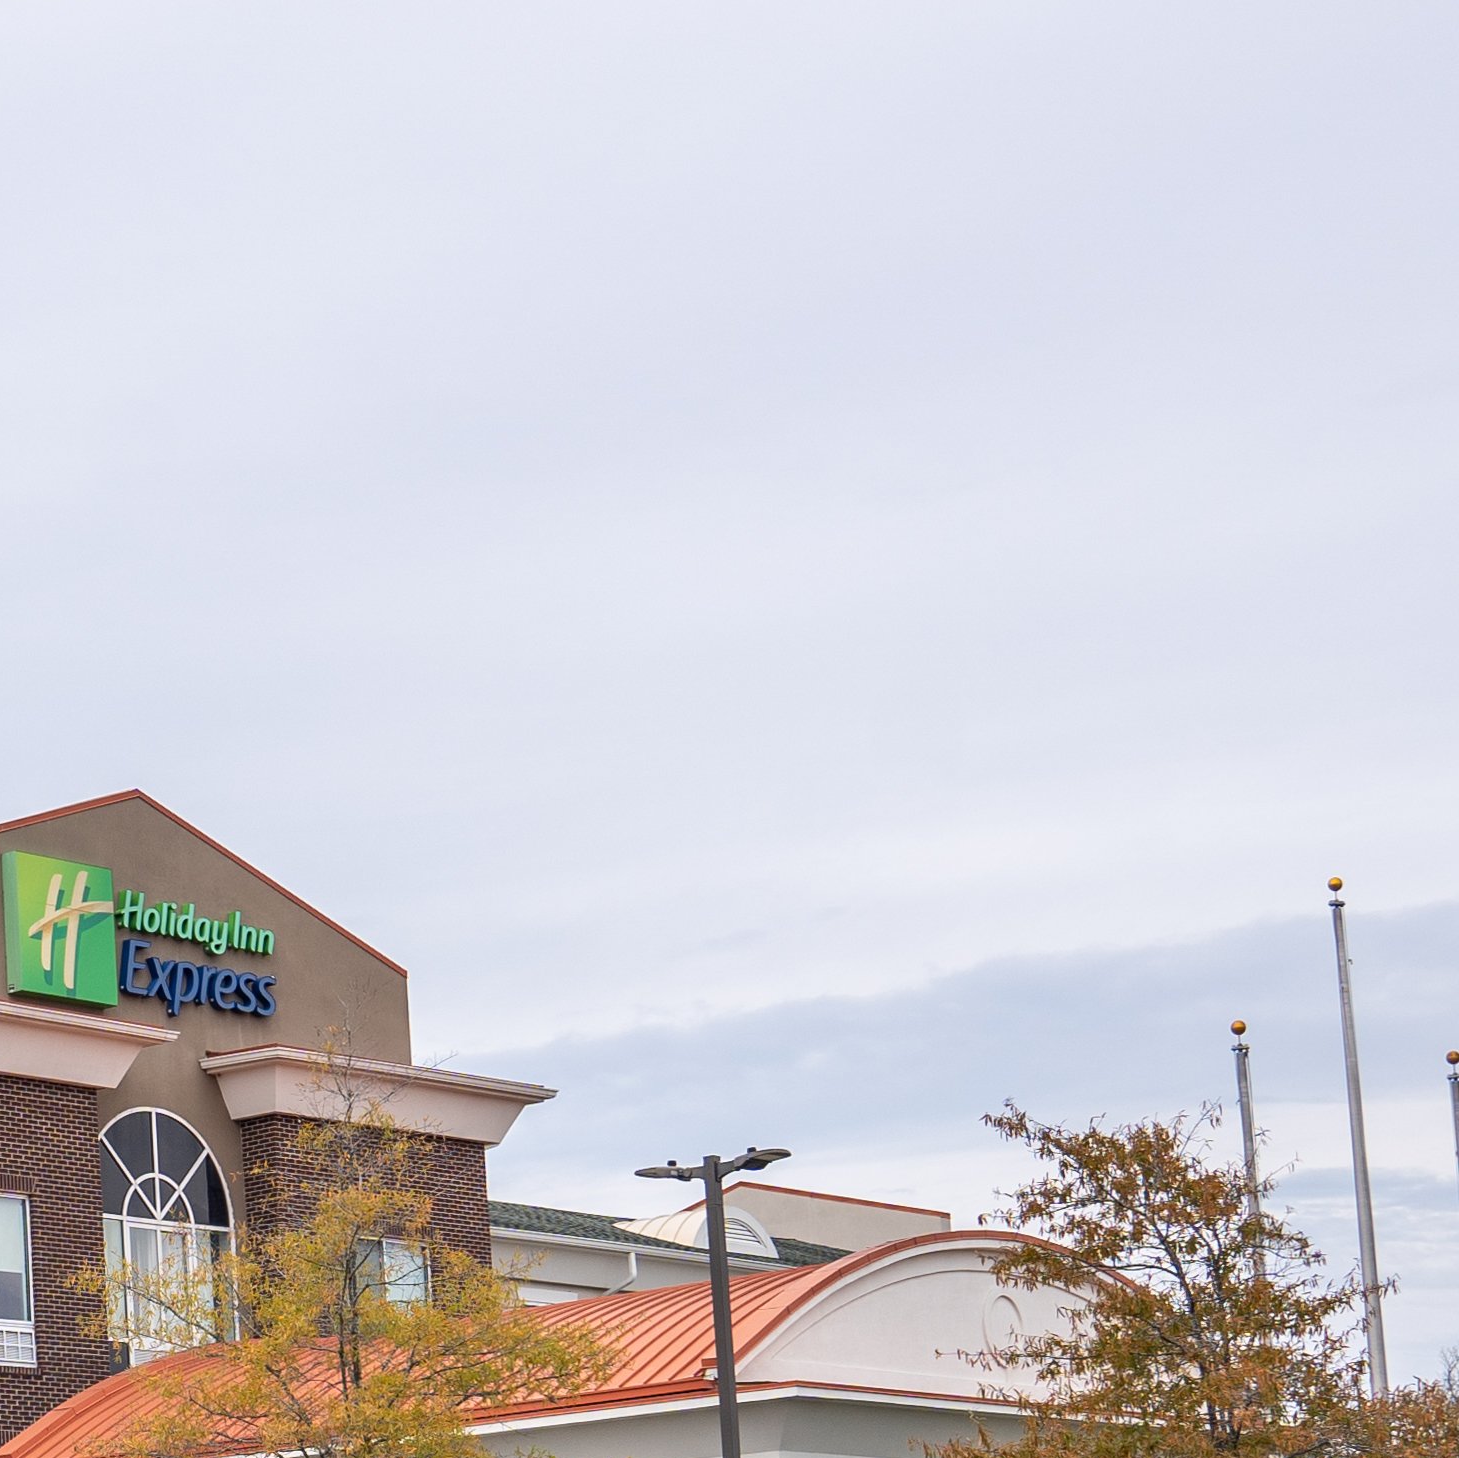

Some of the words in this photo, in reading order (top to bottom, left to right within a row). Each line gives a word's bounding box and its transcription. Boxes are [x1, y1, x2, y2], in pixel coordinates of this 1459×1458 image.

[116, 890, 229, 956] Holiday
[230, 911, 275, 956] Inn
[121, 939, 277, 1017] Express
